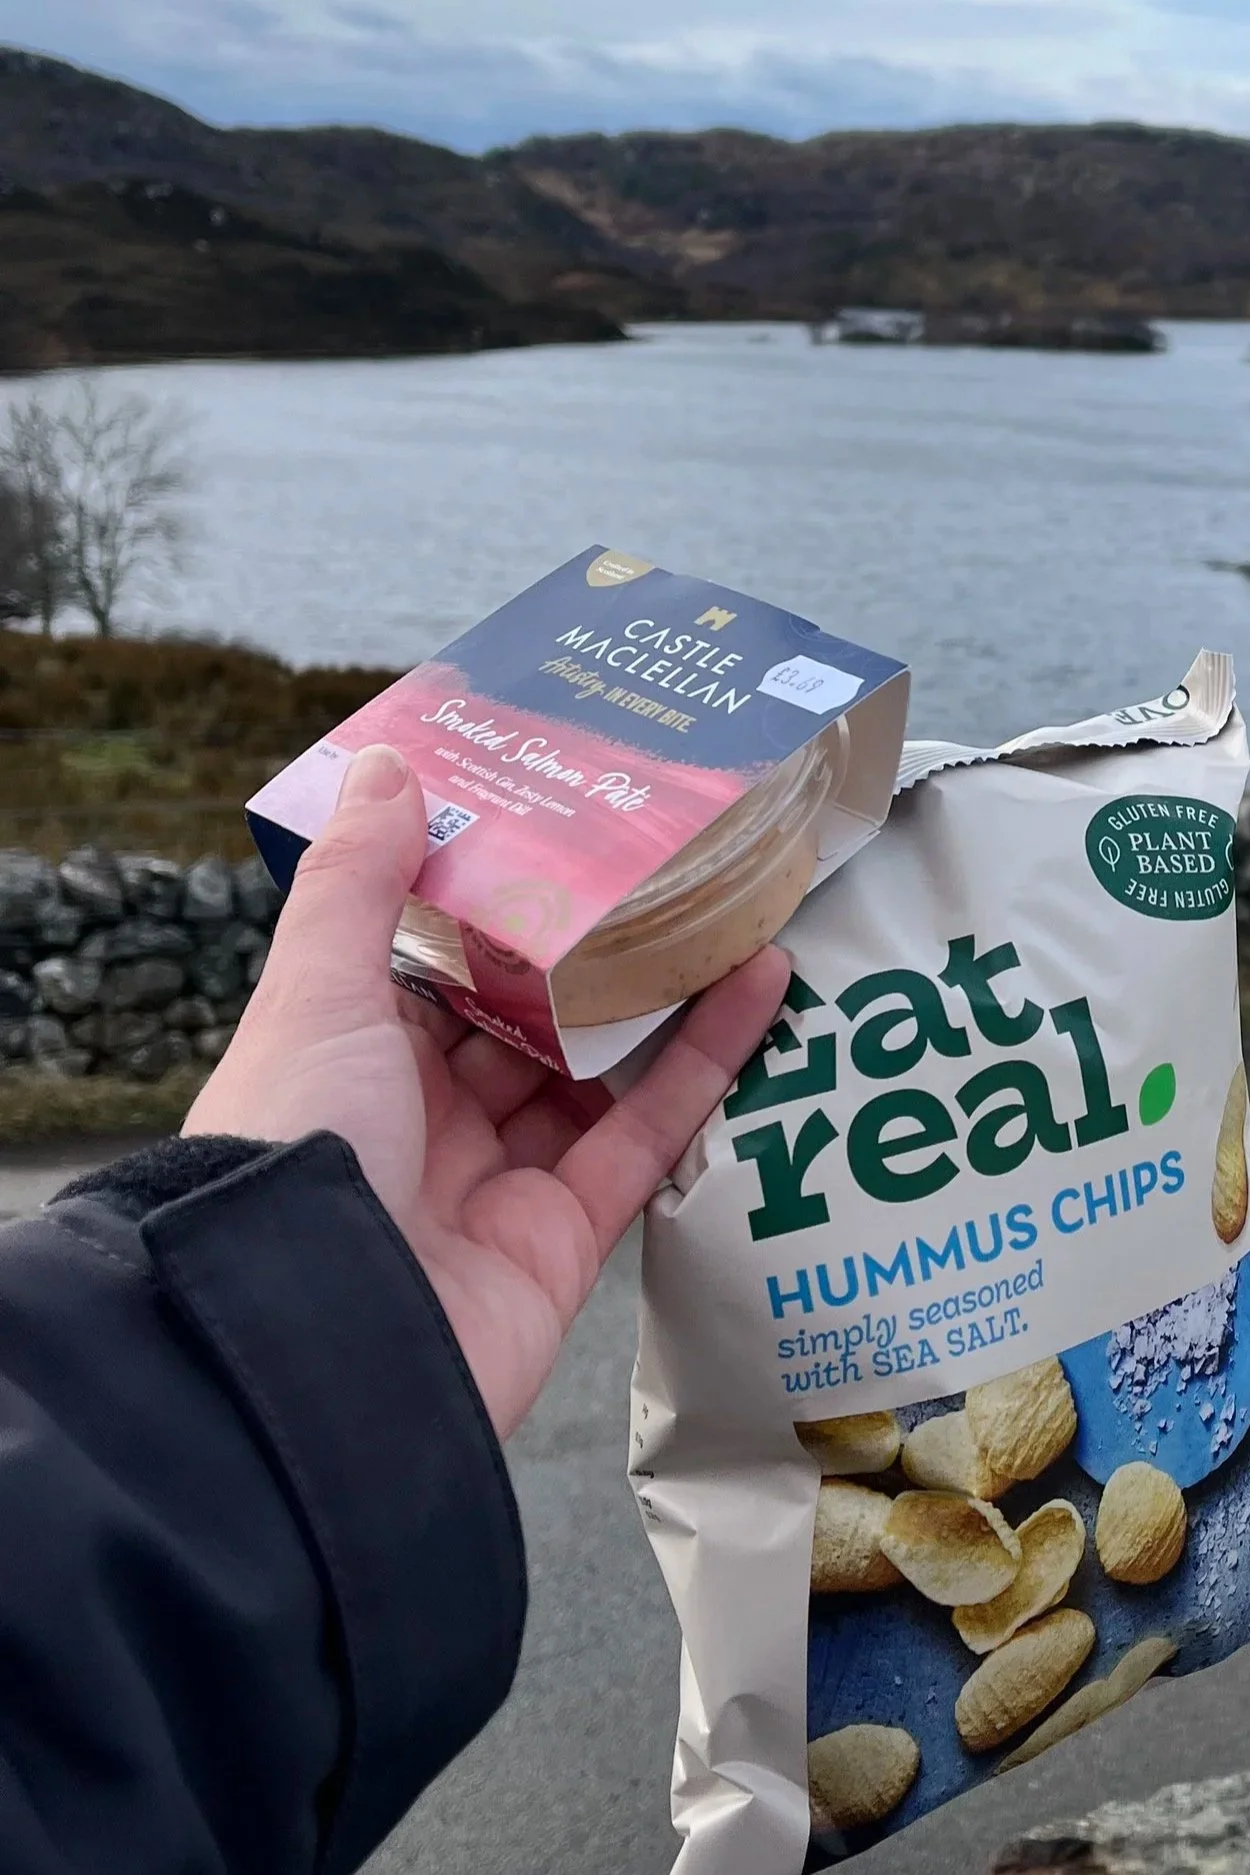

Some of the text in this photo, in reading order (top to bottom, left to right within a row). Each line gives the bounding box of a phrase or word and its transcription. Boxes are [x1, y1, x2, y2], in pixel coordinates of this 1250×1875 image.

[555, 625, 752, 714] MACLELLAN
[623, 619, 744, 675] CASTLE
[771, 666, 825, 694] £3.69
[538, 656, 698, 733] Artistry IN EVERY BITE
[420, 699, 519, 751] Smoked
[501, 737, 588, 787] Salmon
[434, 747, 461, 763] with
[456, 757, 499, 782] Scottish
[513, 785, 544, 804] Zesty
[539, 796, 576, 818] Lemon
[448, 775, 534, 817] and Fragrant Dill
[1107, 803, 1220, 831] GLUTEN FREE
[1128, 831, 1212, 852] PLANT
[1136, 854, 1216, 874] BASED
[1124, 878, 1230, 909] GLUTEN FREE
[723, 934, 1045, 1121] Eat
[766, 1150, 1186, 1319] HUMMUS CHIPS
[777, 1259, 1045, 1362] simply seasoned
[781, 1306, 1030, 1394] with SEA SALT.
